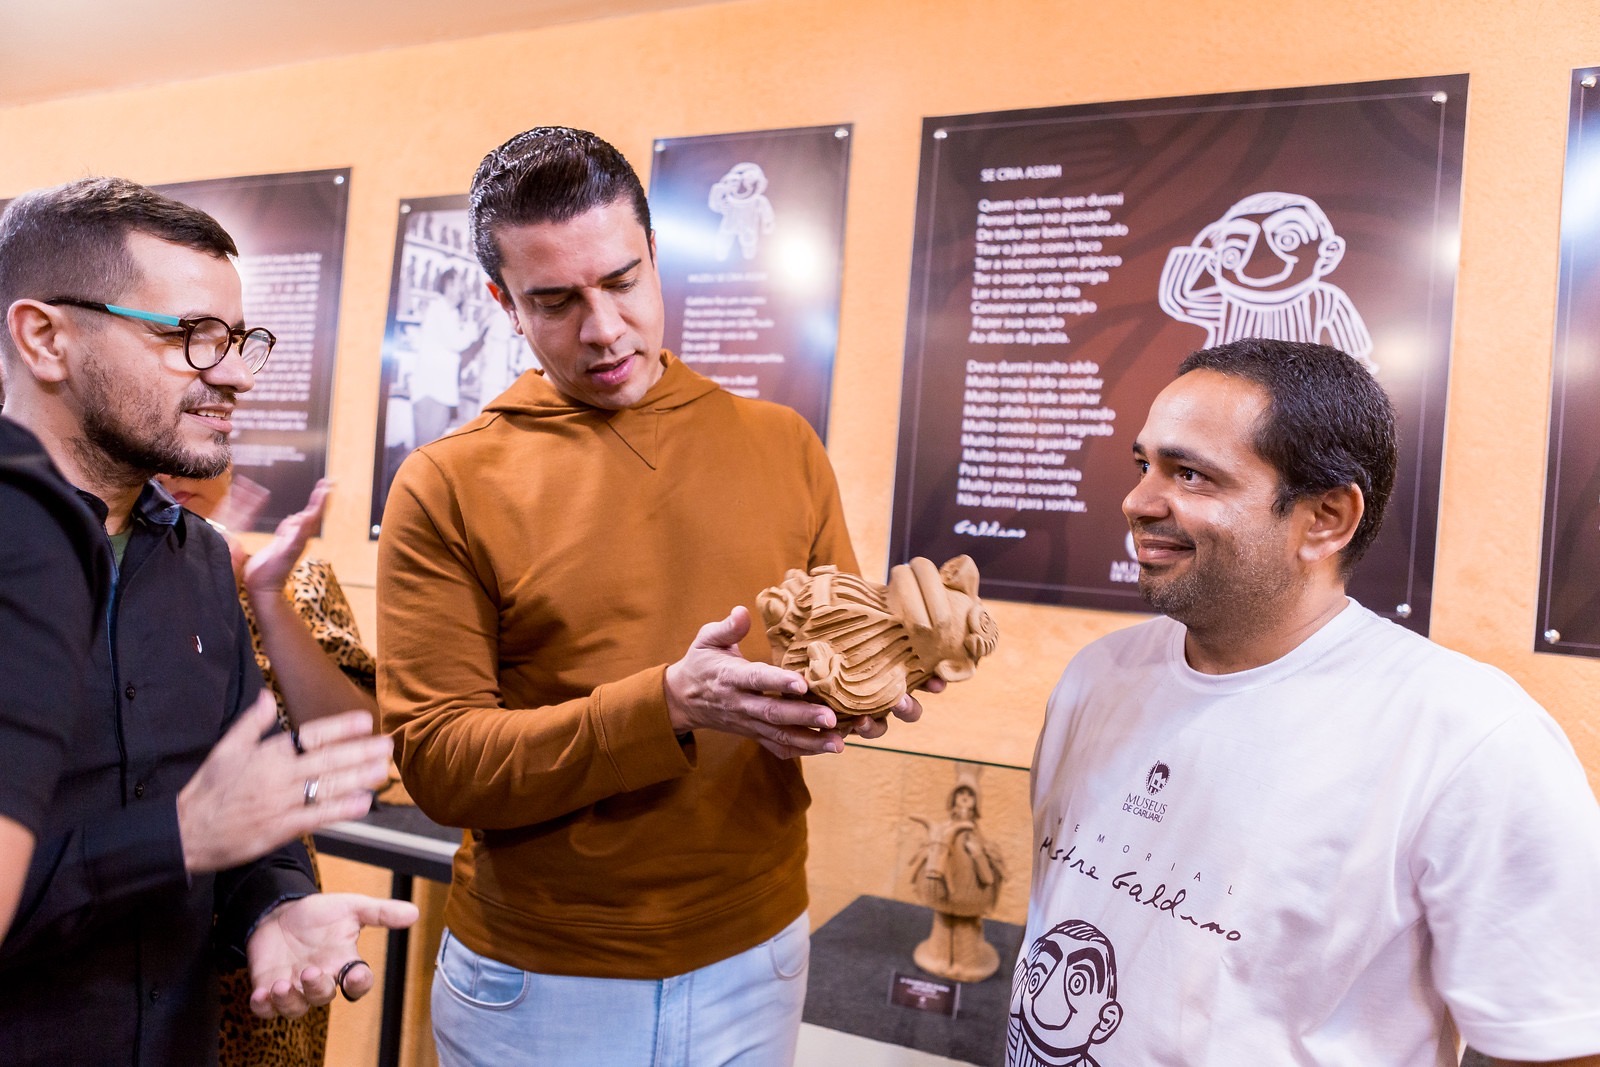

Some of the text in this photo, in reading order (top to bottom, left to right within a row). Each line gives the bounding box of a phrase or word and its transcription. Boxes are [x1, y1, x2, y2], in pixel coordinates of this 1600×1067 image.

[980, 165, 1062, 182] SE CRIA ASSIM
[977, 199, 1014, 213] Quem
[1037, 198, 1061, 209] tem
[1062, 196, 1086, 210] que
[977, 214, 1015, 226] Pensar
[1016, 213, 1043, 225] bem
[1061, 209, 1111, 225] passado
[976, 228, 993, 242] De
[994, 227, 1023, 241] tudo
[1041, 226, 1069, 238] bem
[1070, 223, 1129, 237] lembrado
[1002, 244, 1011, 255] o
[1041, 241, 1075, 254] como
[1075, 240, 1102, 253] loco
[1023, 257, 1057, 269] como
[1058, 257, 1078, 268] um
[992, 273, 1001, 284] o
[1037, 272, 1063, 284] com
[992, 288, 1001, 299] o
[1028, 302, 1055, 314] uma
[966, 360, 997, 374] Deve
[1033, 361, 1068, 374] muito
[965, 375, 1000, 388] Muito
[1000, 376, 1027, 389] mais
[1058, 377, 1103, 390] acordar
[964, 390, 998, 403] Muito
[999, 390, 1026, 403] mais
[1060, 392, 1102, 406] sonhar
[963, 404, 997, 418] Muito
[1039, 407, 1078, 420] menos
[1079, 407, 1116, 422] medo
[962, 419, 997, 433] Muito
[1037, 423, 1064, 435] com
[1065, 422, 1114, 438] segredo
[961, 434, 1082, 452] Muito menos guardar
[962, 449, 997, 463] Muito
[997, 451, 1025, 463] mais
[996, 466, 1024, 478] mais
[958, 479, 992, 492] Muito
[1017, 498, 1043, 511] para
[1126, 793, 1168, 814] MUSEUS
[1122, 803, 1163, 823] DE CARUARU
